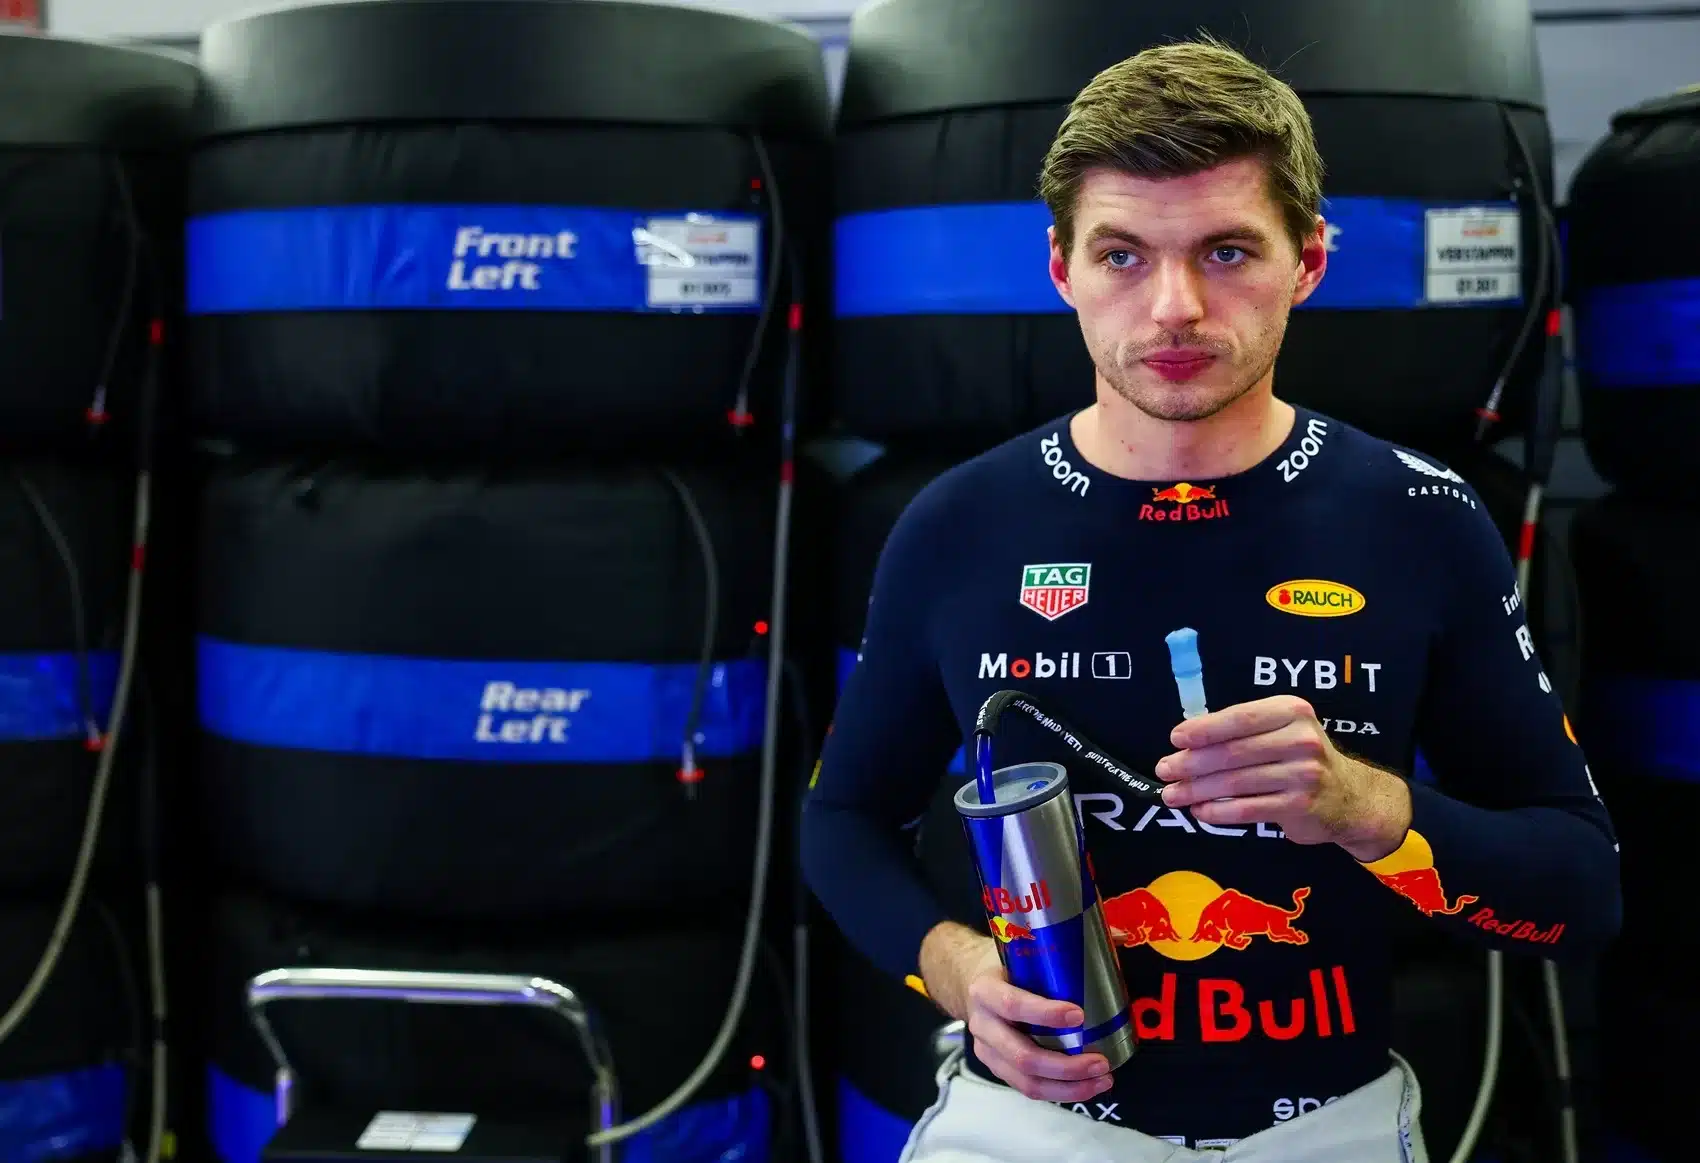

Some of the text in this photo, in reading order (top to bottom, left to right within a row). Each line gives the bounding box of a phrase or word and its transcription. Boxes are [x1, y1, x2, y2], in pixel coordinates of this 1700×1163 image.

[452, 225, 579, 259] Front
[447, 260, 543, 290] Left
[1041, 432, 1090, 497] zoom
[1276, 419, 1328, 482] zoom
[1139, 499, 1231, 521] Red Bull
[1029, 567, 1083, 585] TAG
[1024, 589, 1084, 615] HEUER
[1293, 590, 1353, 608] RAUCH
[978, 652, 1080, 679] Mobil
[1254, 655, 1381, 692] BYBIT
[479, 680, 593, 713] Rear
[473, 711, 572, 744] Left
[1040, 717, 1062, 732] WILD
[1063, 732, 1083, 752] YETI
[1085, 751, 1109, 765] BUILT
[1104, 762, 1120, 775] FOR
[1117, 770, 1133, 782] THE
[1127, 778, 1150, 791] WILD
[993, 879, 1052, 914] Bull
[1468, 907, 1566, 944] Red Bull
[1198, 965, 1356, 1042] Bull
[1273, 1096, 1340, 1120] sp
